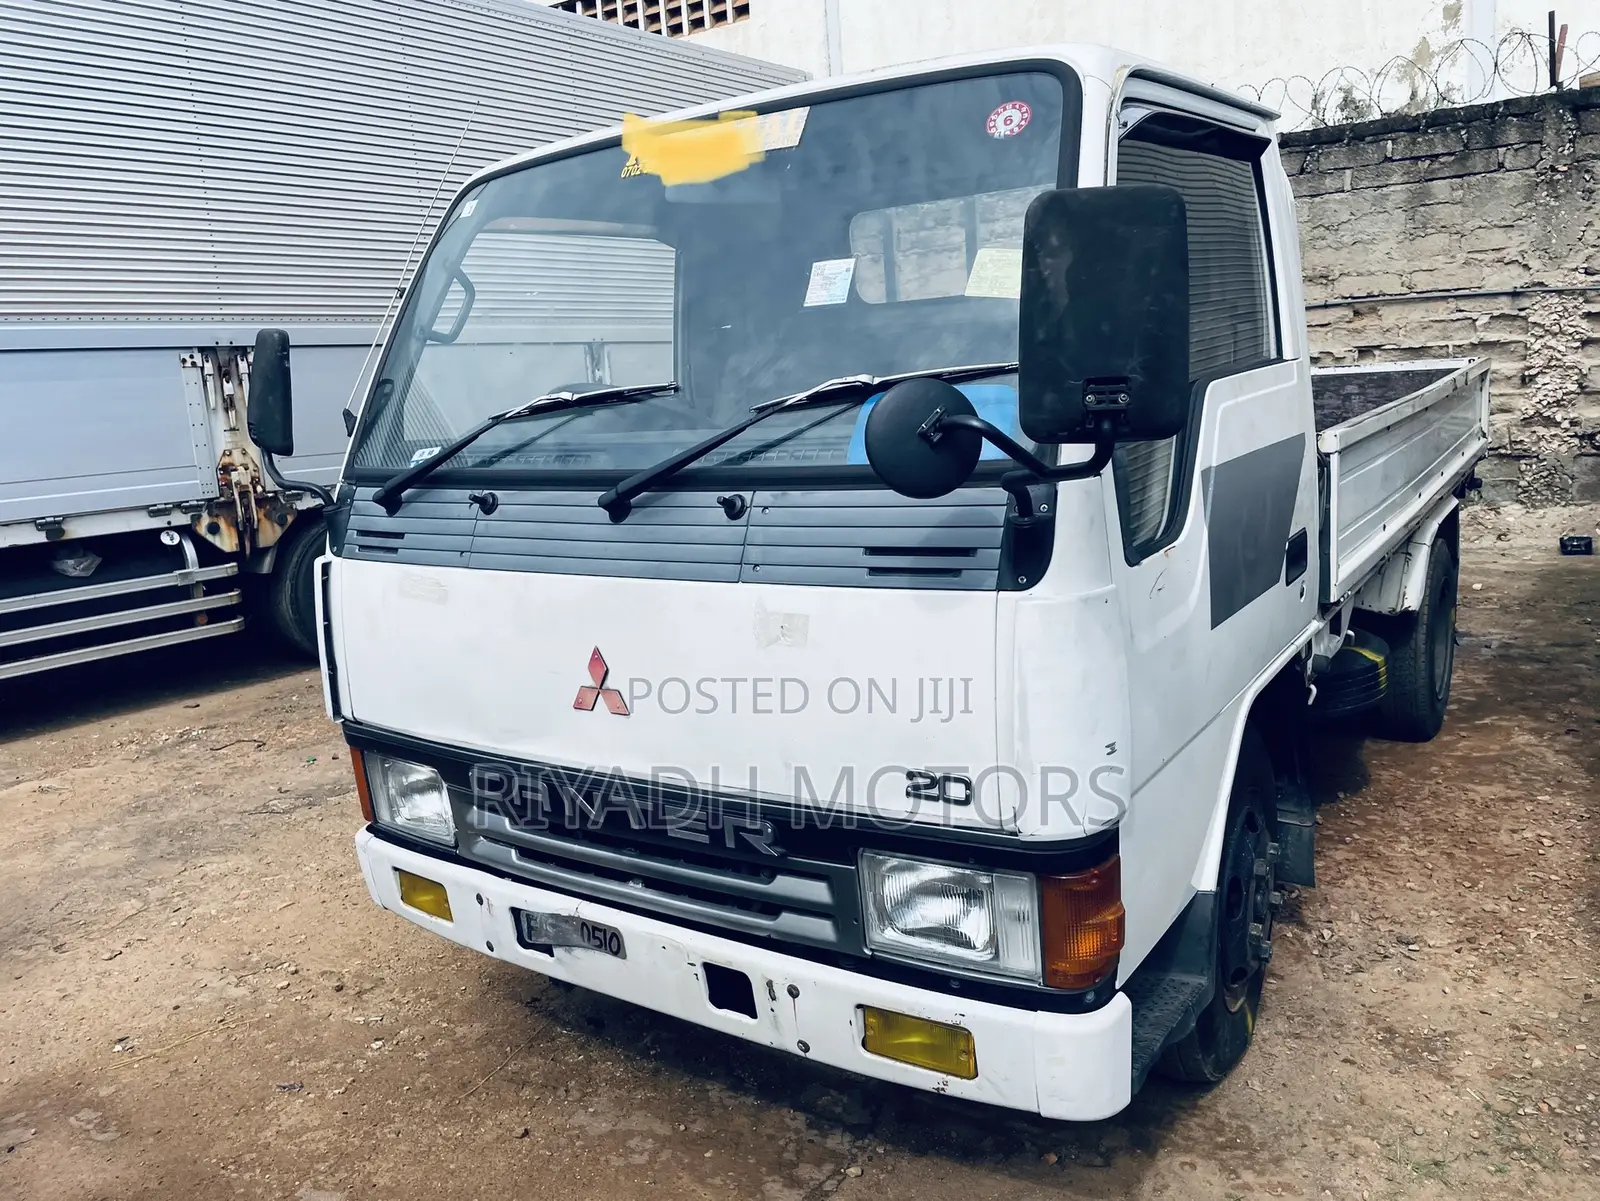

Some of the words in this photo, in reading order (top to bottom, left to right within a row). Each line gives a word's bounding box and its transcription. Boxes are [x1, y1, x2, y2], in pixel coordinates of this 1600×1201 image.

[1003, 115, 1013, 126] 6
[906, 768, 972, 806] 20
[580, 921, 621, 956] 0510
